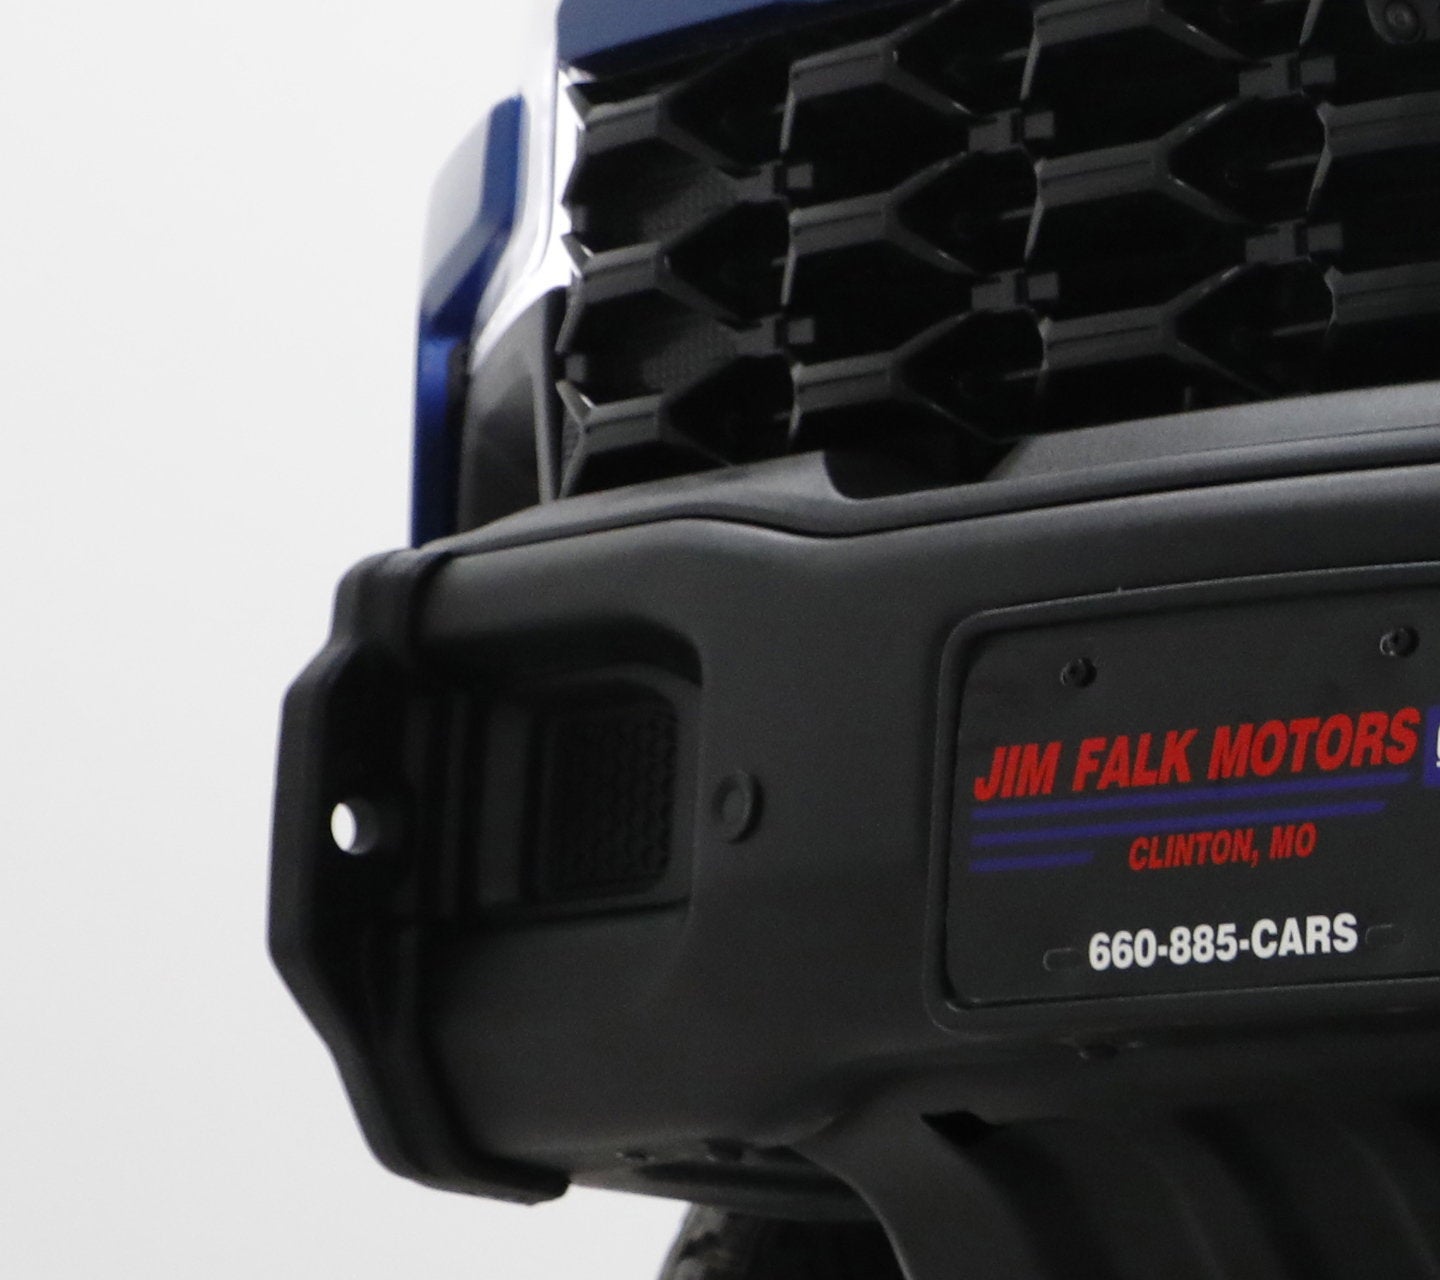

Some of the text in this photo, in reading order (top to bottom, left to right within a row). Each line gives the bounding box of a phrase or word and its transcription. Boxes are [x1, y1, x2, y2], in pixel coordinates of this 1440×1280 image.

[973, 706, 1422, 802] JIM FALK MOTORS
[1127, 822, 1318, 871] CLINTON, MO
[1088, 912, 1359, 971] 660-885-CARS
